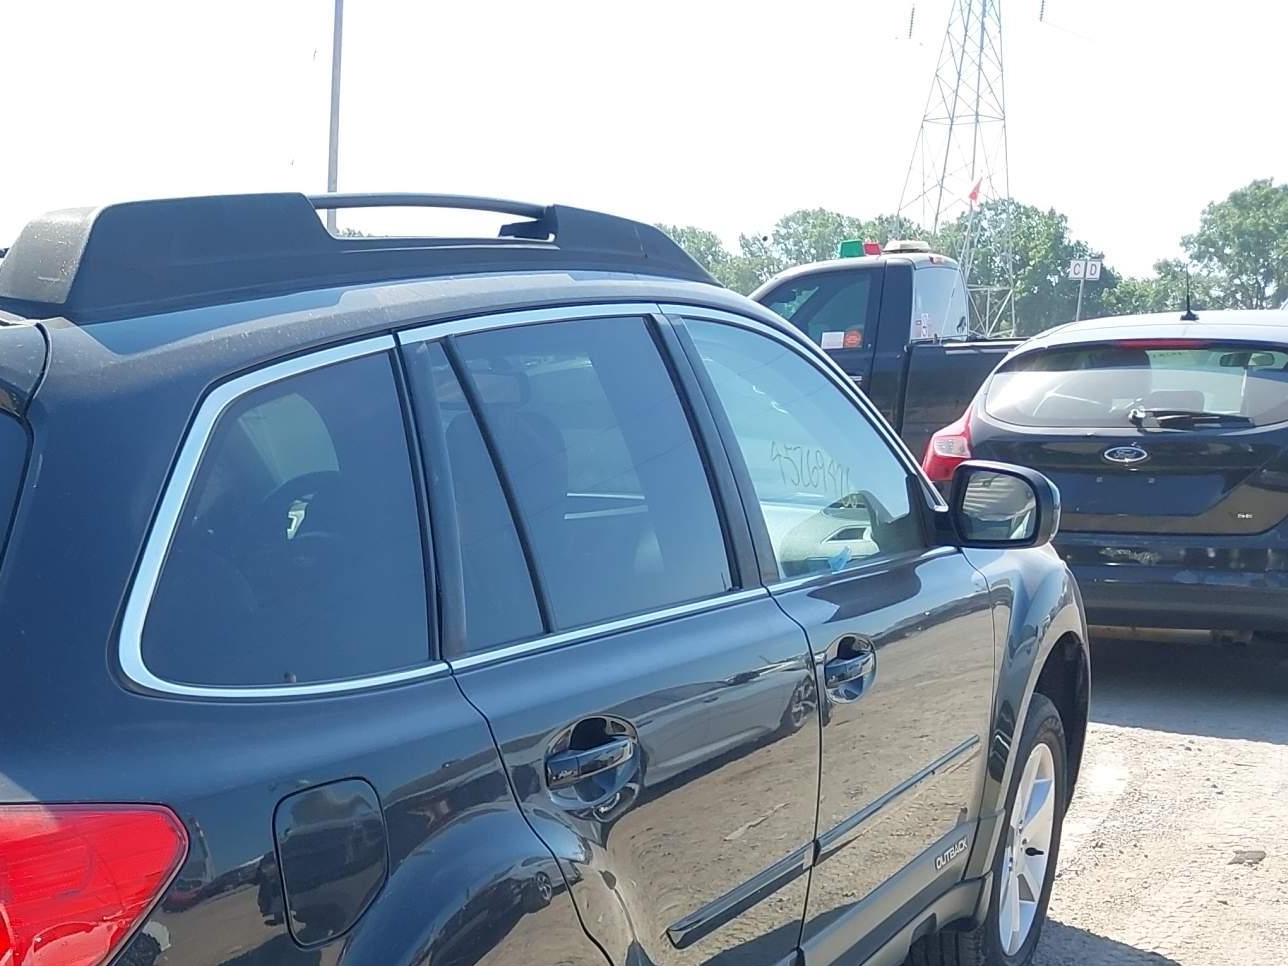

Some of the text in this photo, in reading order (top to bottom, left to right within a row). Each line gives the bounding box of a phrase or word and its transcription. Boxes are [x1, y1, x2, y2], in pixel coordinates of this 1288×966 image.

[1073, 262, 1098, 276] C D
[935, 836, 968, 870] OUTBACK
